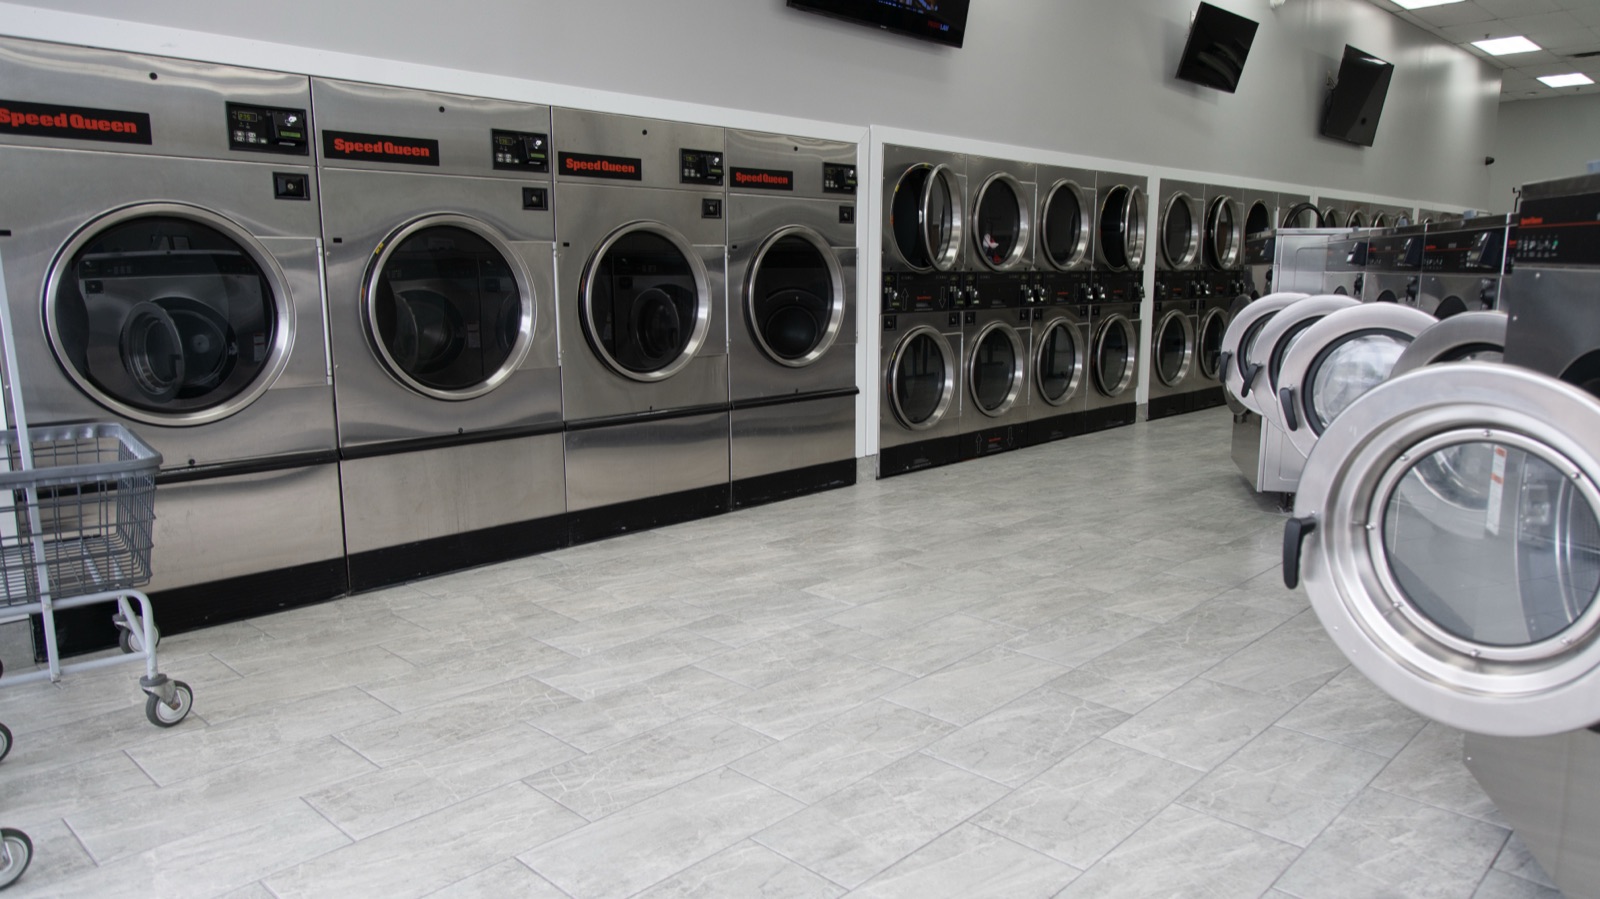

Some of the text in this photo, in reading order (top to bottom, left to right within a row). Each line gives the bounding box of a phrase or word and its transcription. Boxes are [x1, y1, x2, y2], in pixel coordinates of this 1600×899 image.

[0, 108, 138, 133] Speed Queen
[334, 138, 430, 157] Speed Queen
[565, 158, 636, 174] Speed Queen
[735, 171, 789, 185] Speed Queen
